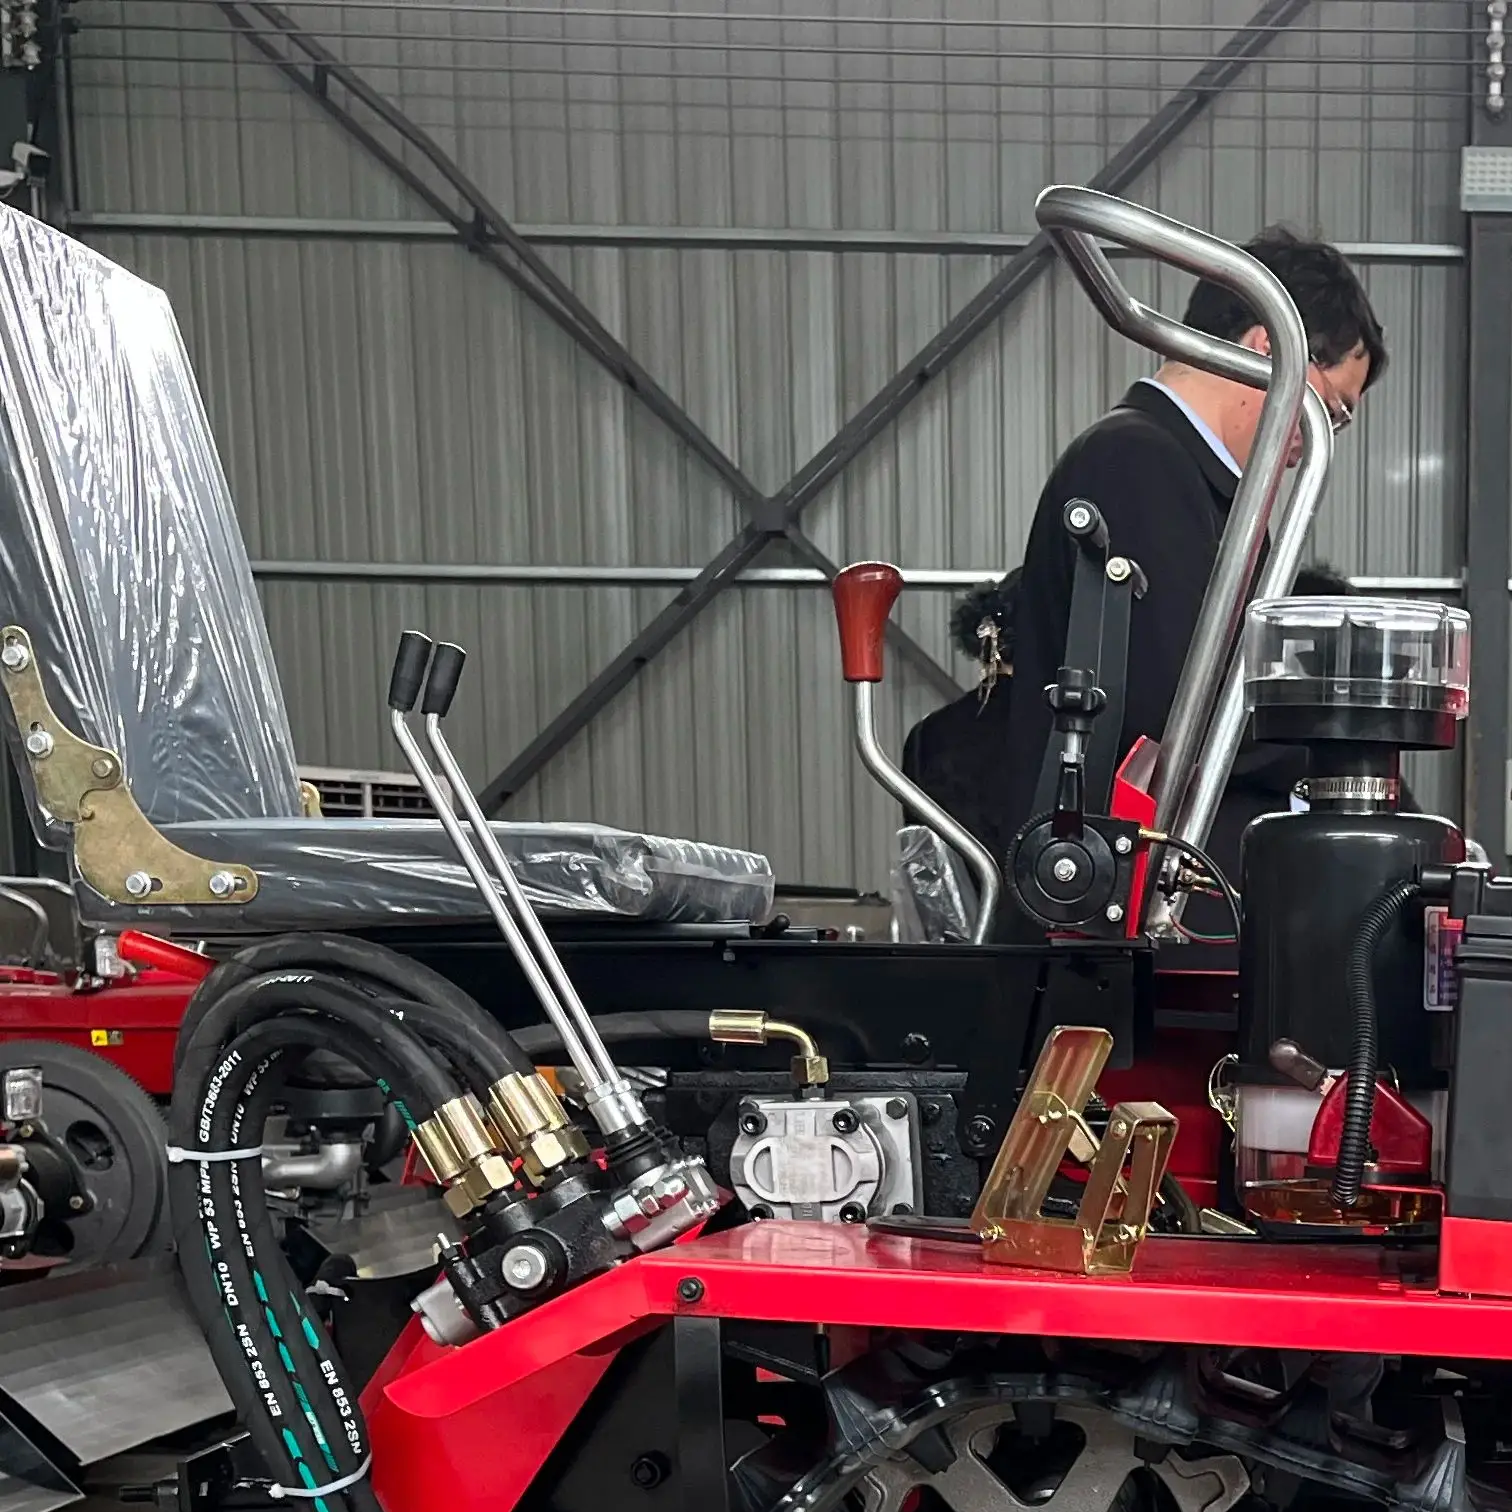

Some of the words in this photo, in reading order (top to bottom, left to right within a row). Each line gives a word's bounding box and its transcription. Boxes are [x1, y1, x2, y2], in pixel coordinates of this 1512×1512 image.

[202, 1197, 215, 1217] 53
[206, 1220, 222, 1250] WP
[217, 1261, 239, 1307] DN10
[236, 1323, 258, 1358] 2SN
[251, 1360, 271, 1389] 853
[264, 1392, 282, 1417] EN
[320, 1359, 339, 1386] EN
[332, 1387, 352, 1418] 853
[344, 1419, 362, 1455] 2SN
